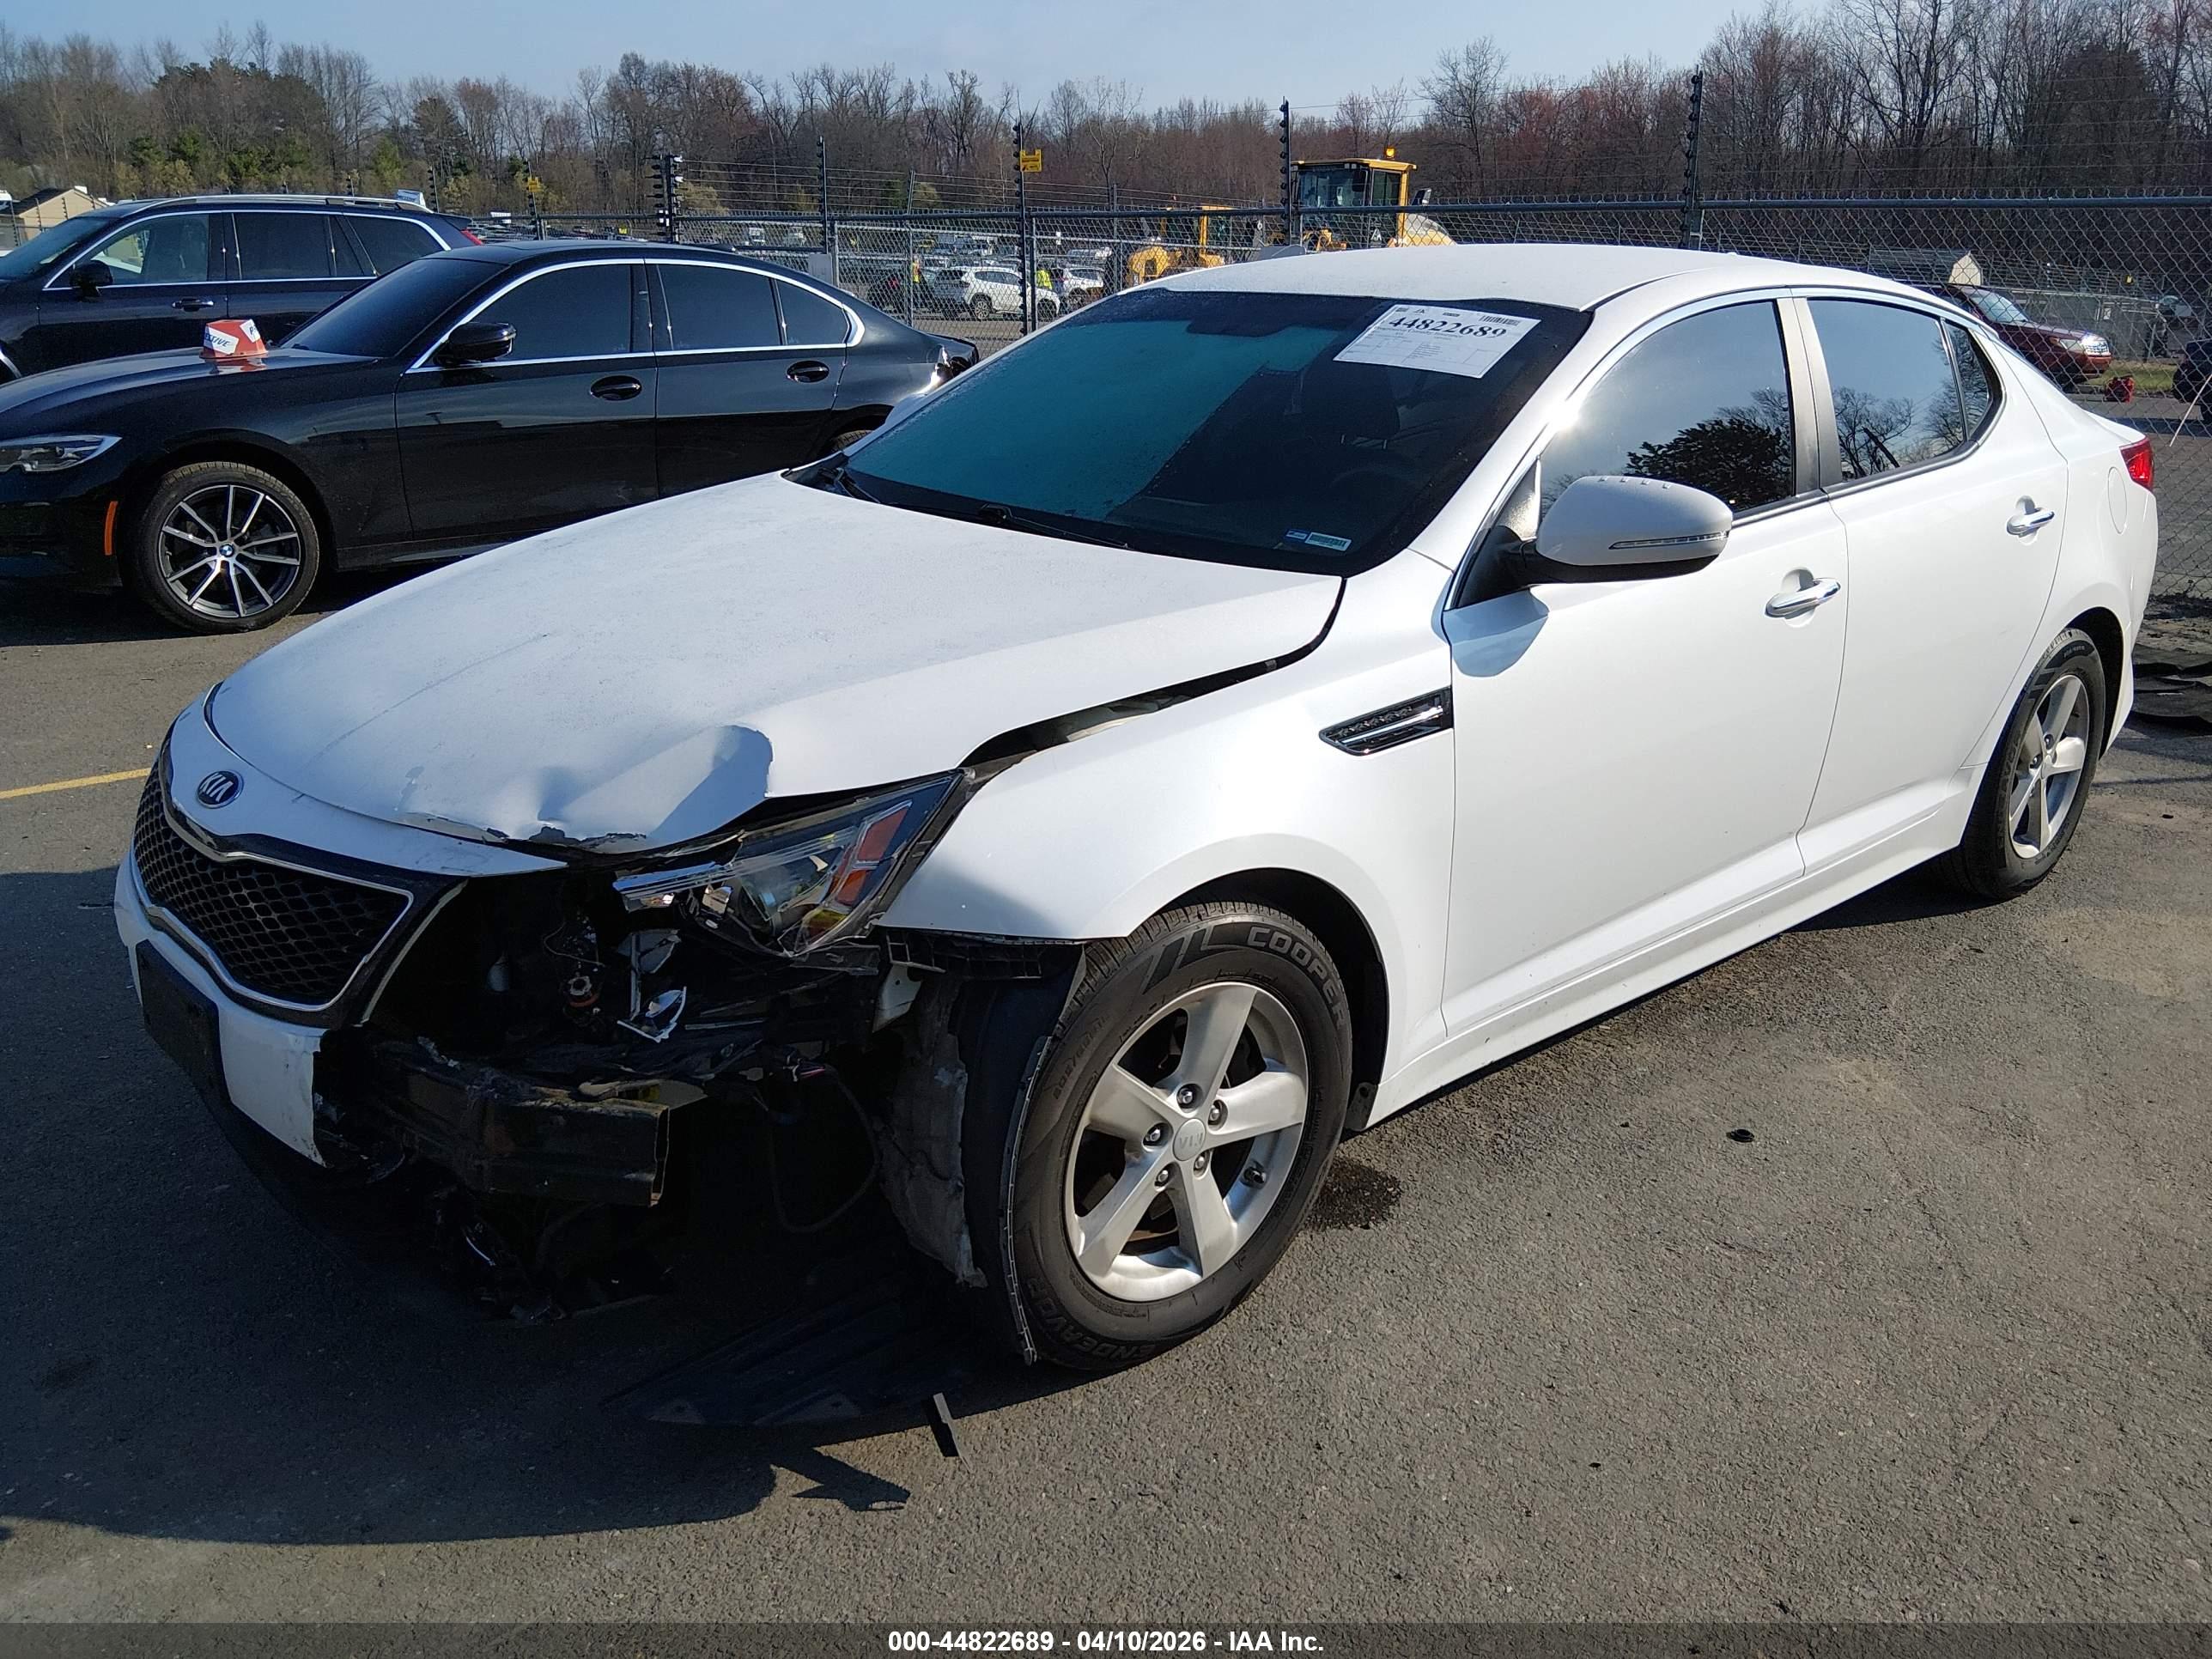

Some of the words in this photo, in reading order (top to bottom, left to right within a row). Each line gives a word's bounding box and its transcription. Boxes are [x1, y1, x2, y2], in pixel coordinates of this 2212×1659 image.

[1389, 316, 1507, 337] 44822689
[198, 772, 234, 803] KIA
[1247, 926, 1349, 1031] COOPER
